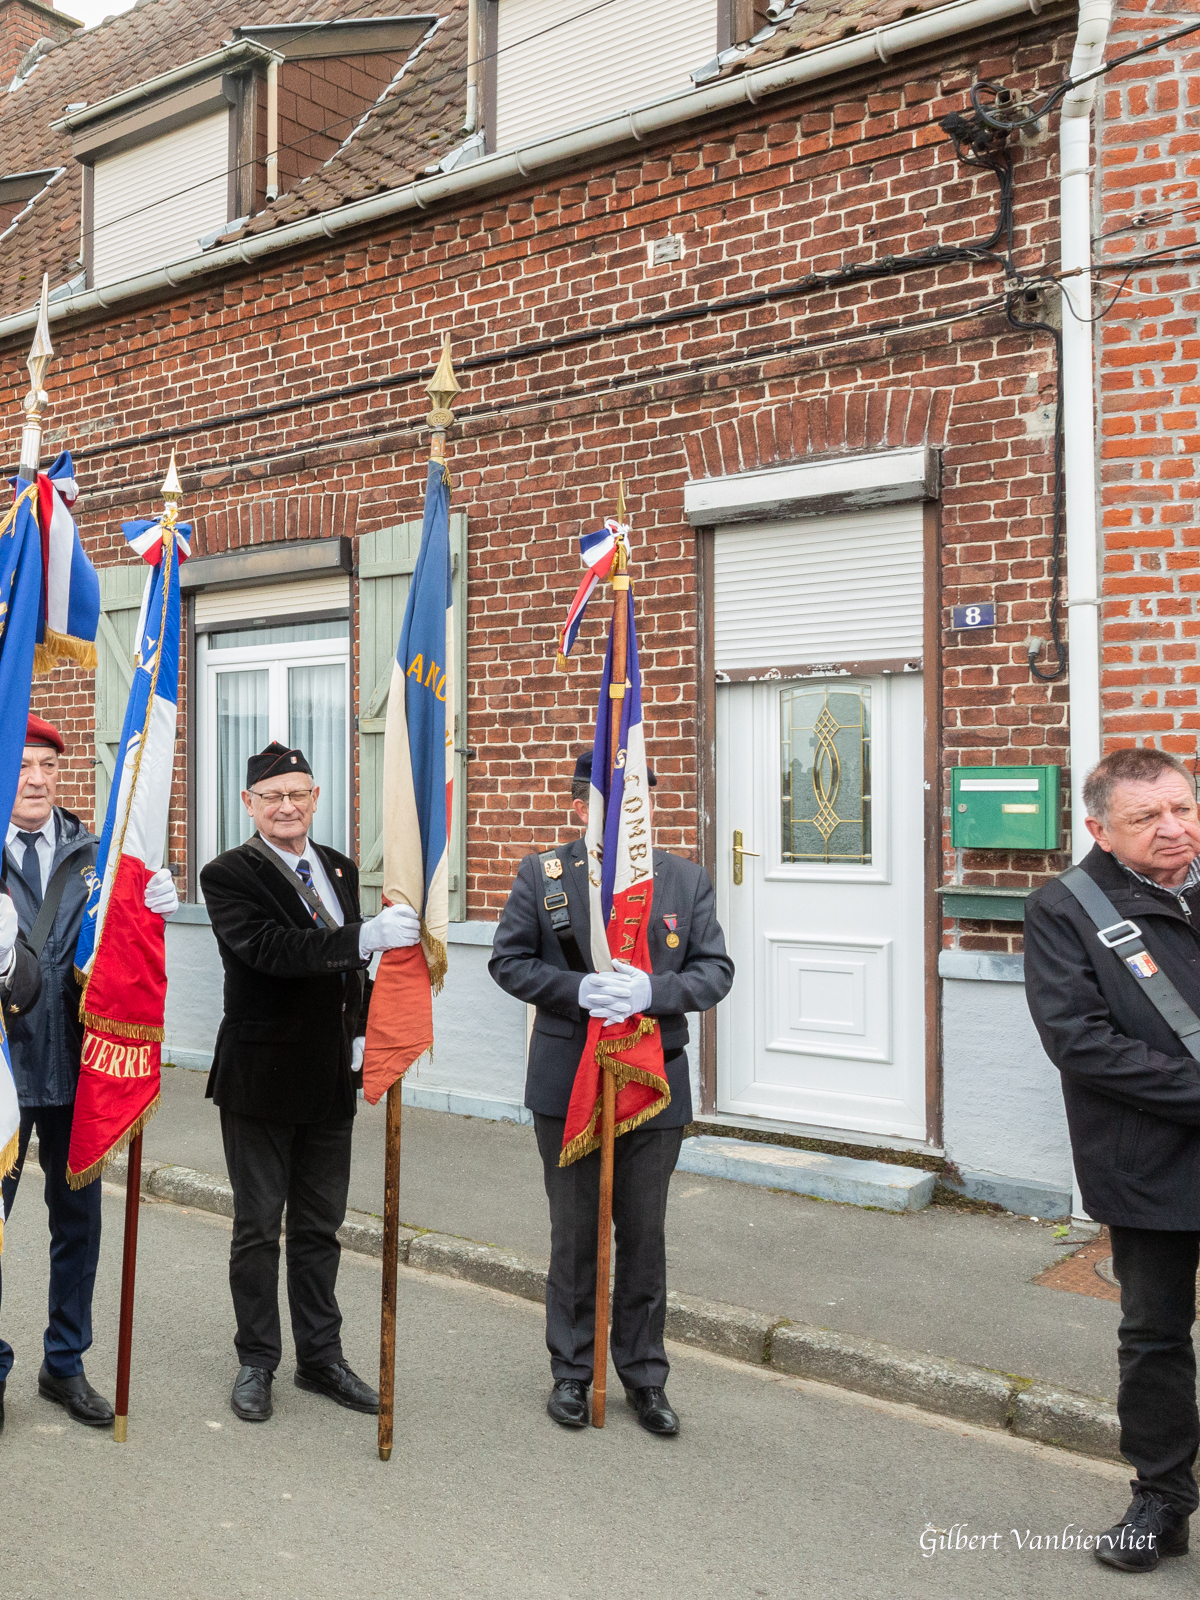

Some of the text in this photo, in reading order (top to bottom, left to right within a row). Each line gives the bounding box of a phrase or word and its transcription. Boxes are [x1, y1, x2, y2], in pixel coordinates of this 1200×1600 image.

[965, 606, 981, 626] 8
[618, 774, 650, 965] COMBATTA
[80, 1031, 151, 1078] UERRE
